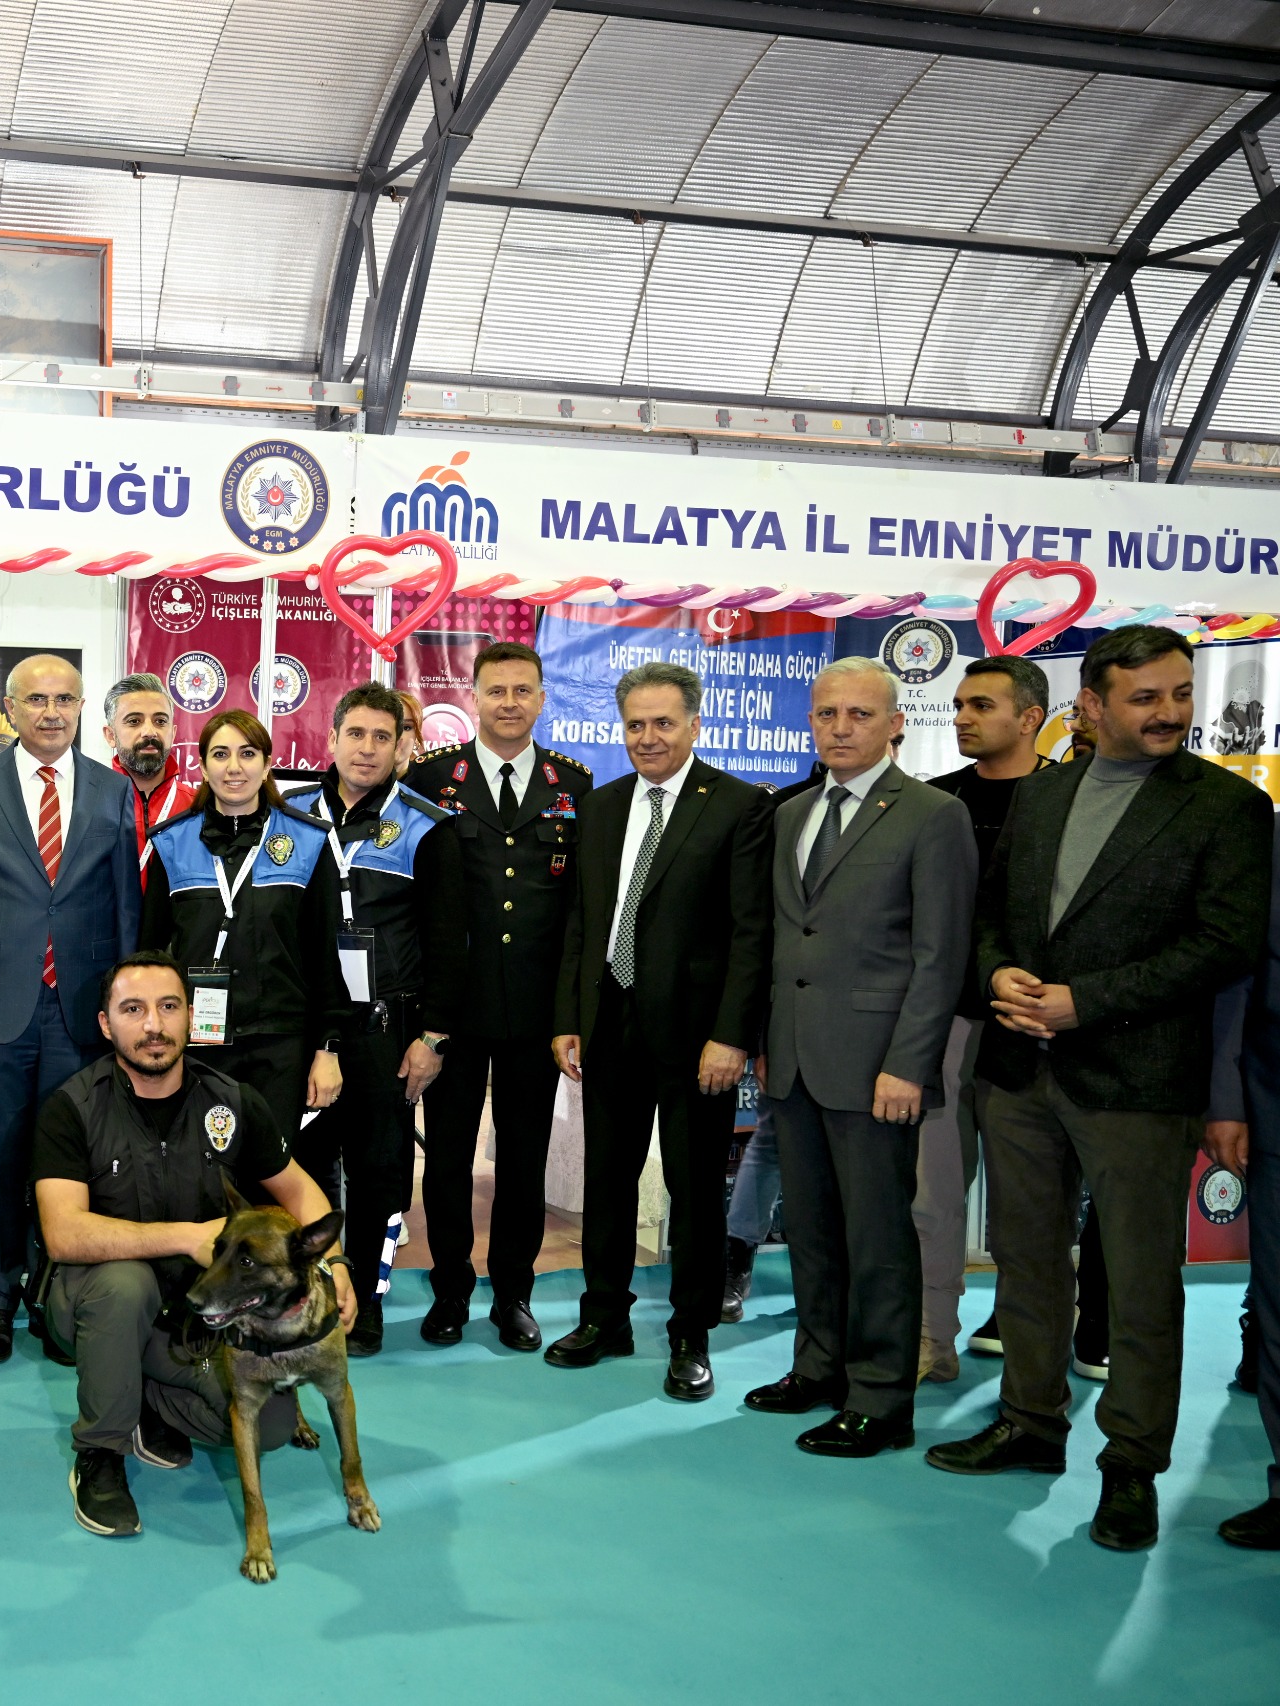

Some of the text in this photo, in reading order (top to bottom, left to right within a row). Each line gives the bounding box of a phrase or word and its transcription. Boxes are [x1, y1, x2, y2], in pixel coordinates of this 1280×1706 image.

[225, 444, 326, 511] MALATYA EMNİYET MÜDÜRLÜĞÜ
[265, 530, 283, 538] EGM
[541, 498, 1279, 576] MALATYA İL EMNİYET MÜDÜR
[453, 545, 498, 561] ALİLİĞİ
[211, 592, 328, 608] TÜRKİYE MHURİYE
[211, 605, 337, 621] İÇİŞLERİ AKANLIĞI
[886, 621, 952, 660] MALATYA EMNİYET MÜDÜRLÜĞÜ
[669, 644, 746, 679] GELİŞTİREN
[749, 652, 781, 678] DAHA
[170, 662, 182, 686] MALATYA
[448, 682, 474, 690] MÜDÜRLÜ
[908, 689, 926, 698] T.C.
[740, 681, 773, 728] İÇİN
[552, 720, 811, 753] KORSA KLİT ÜRÜNE
[727, 755, 798, 774] MÜDÜRLÜĞÜ
